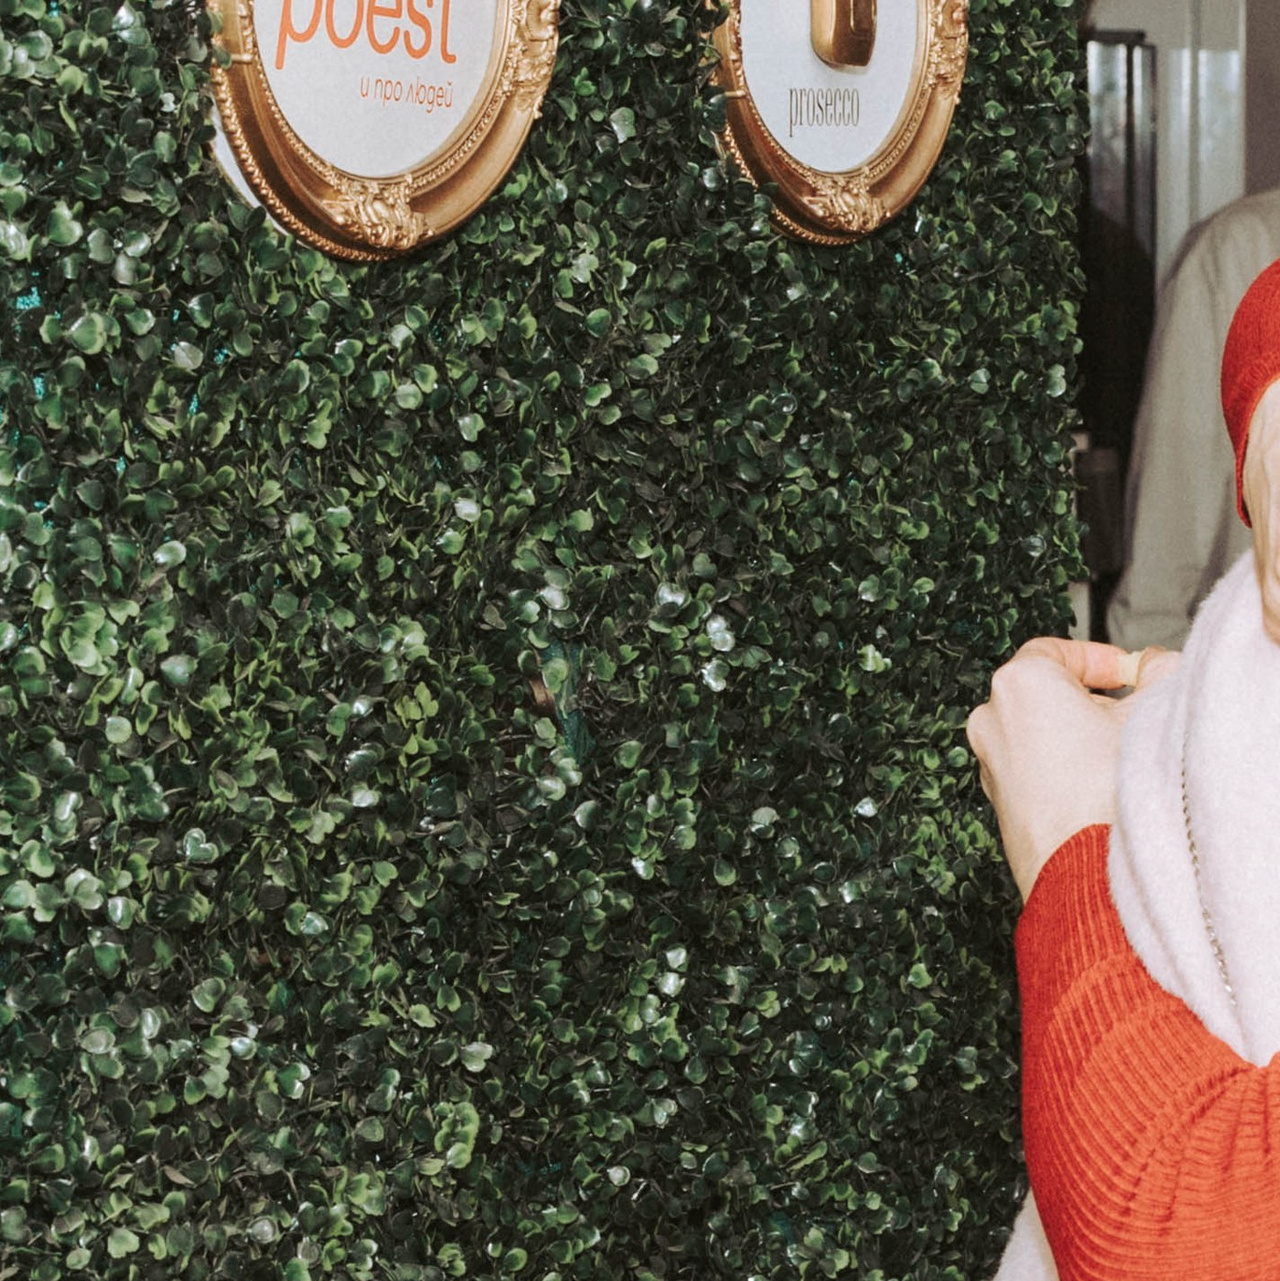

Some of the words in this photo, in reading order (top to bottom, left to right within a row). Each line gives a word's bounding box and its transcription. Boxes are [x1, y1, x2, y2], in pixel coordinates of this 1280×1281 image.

[374, 78, 403, 107] про
[405, 75, 454, 114] людей
[789, 87, 860, 137] prosecco
